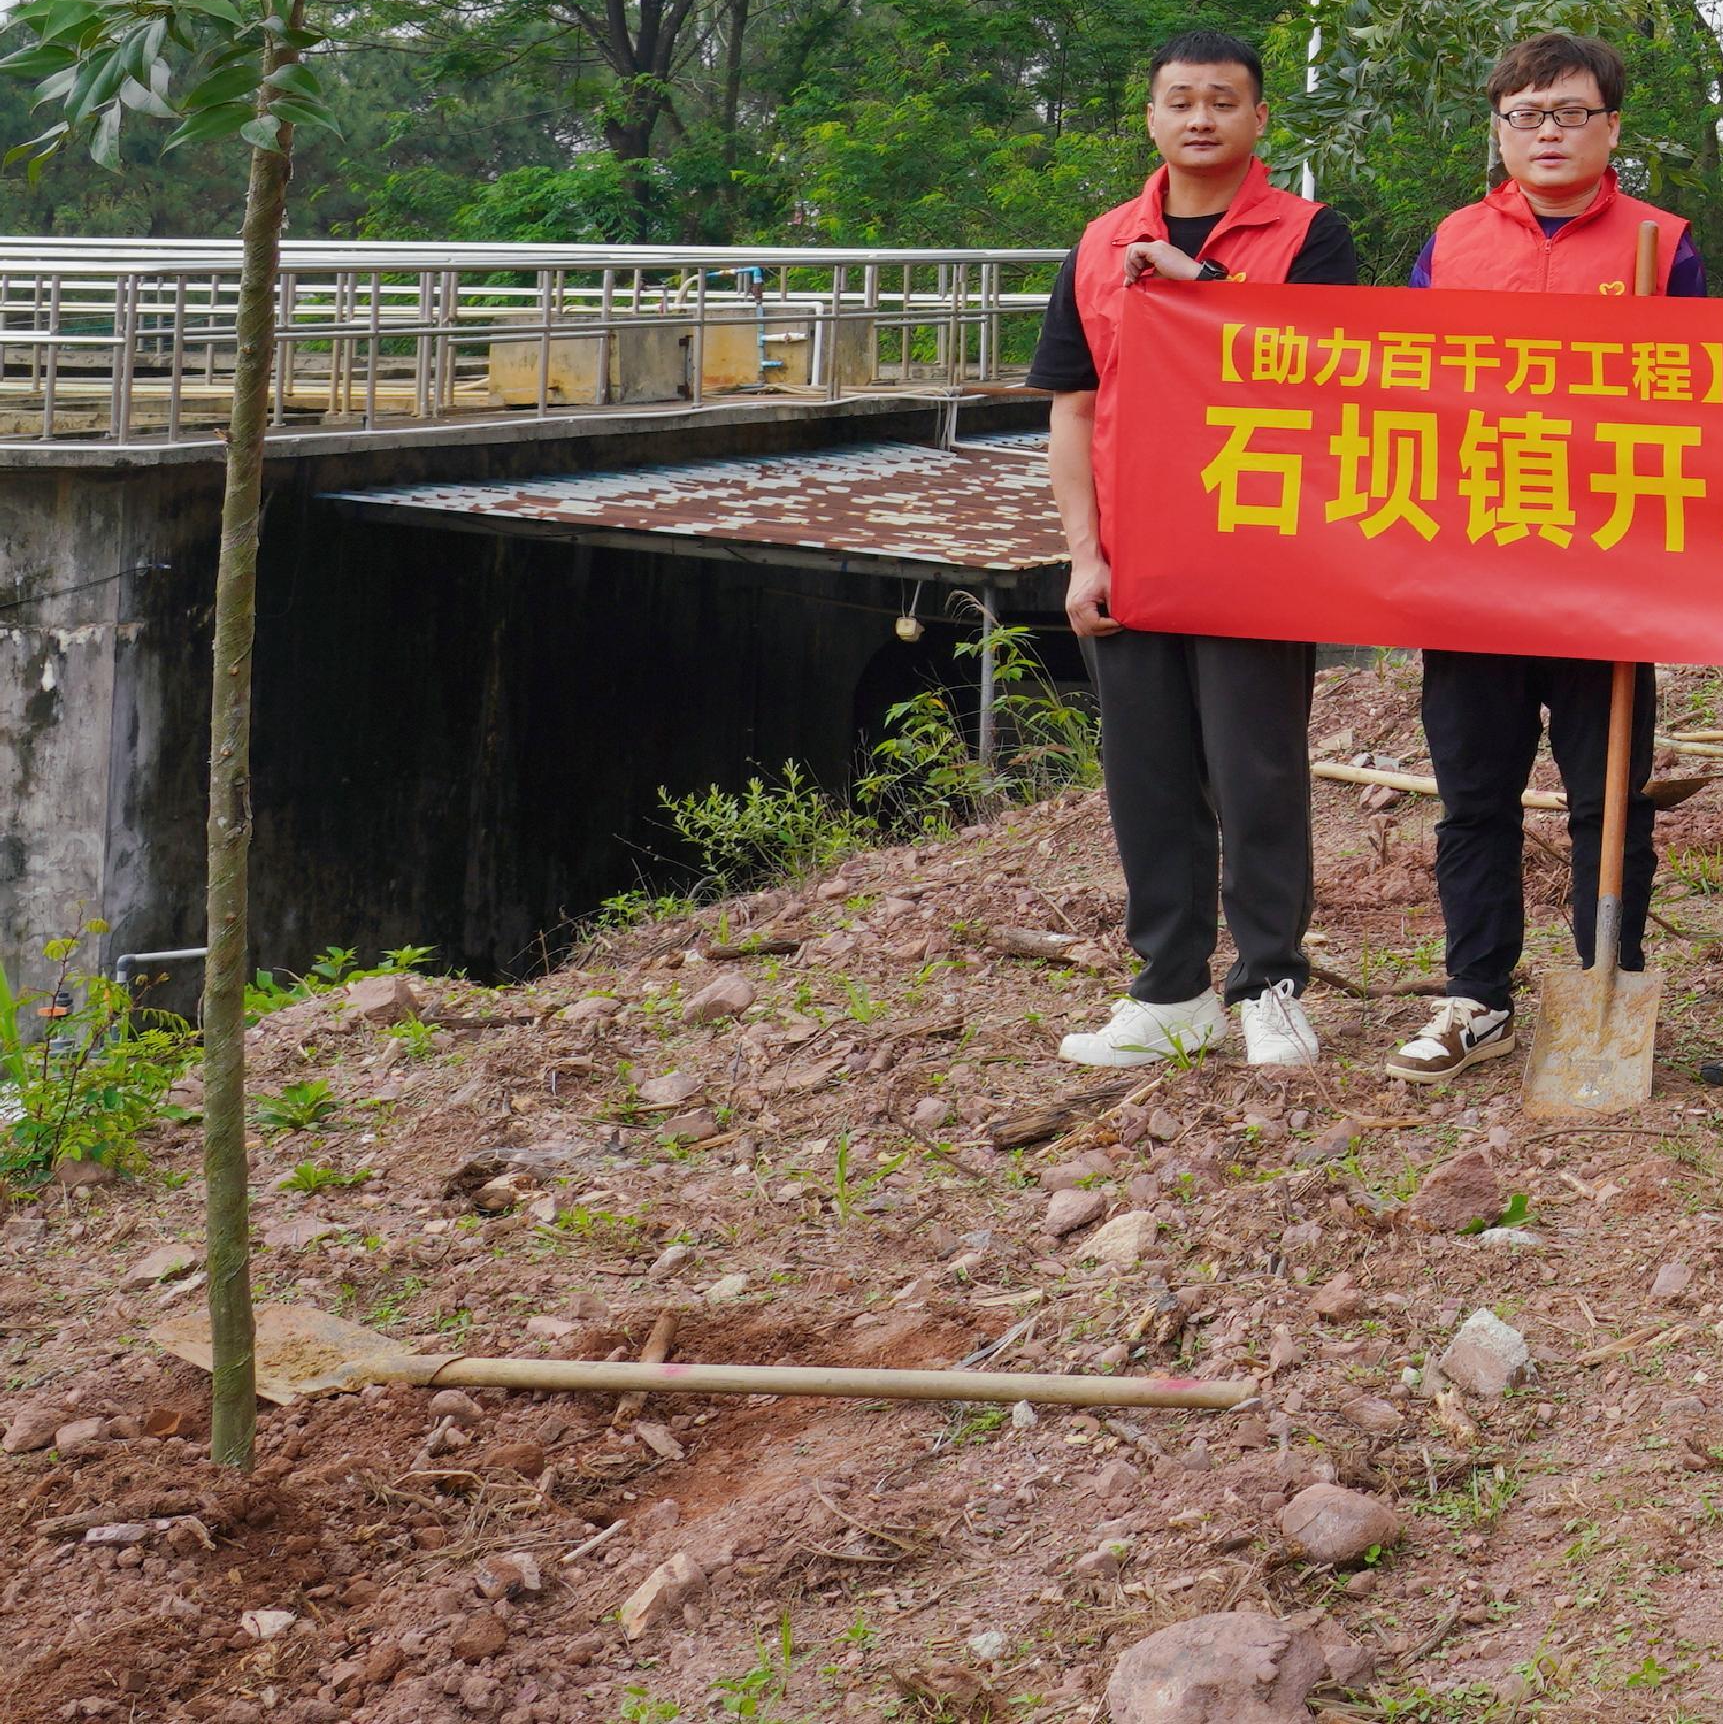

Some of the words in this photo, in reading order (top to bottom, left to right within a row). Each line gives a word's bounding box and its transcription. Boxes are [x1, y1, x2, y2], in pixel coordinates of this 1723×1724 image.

[1222, 324, 1723, 404] 【助力百千万工程】
